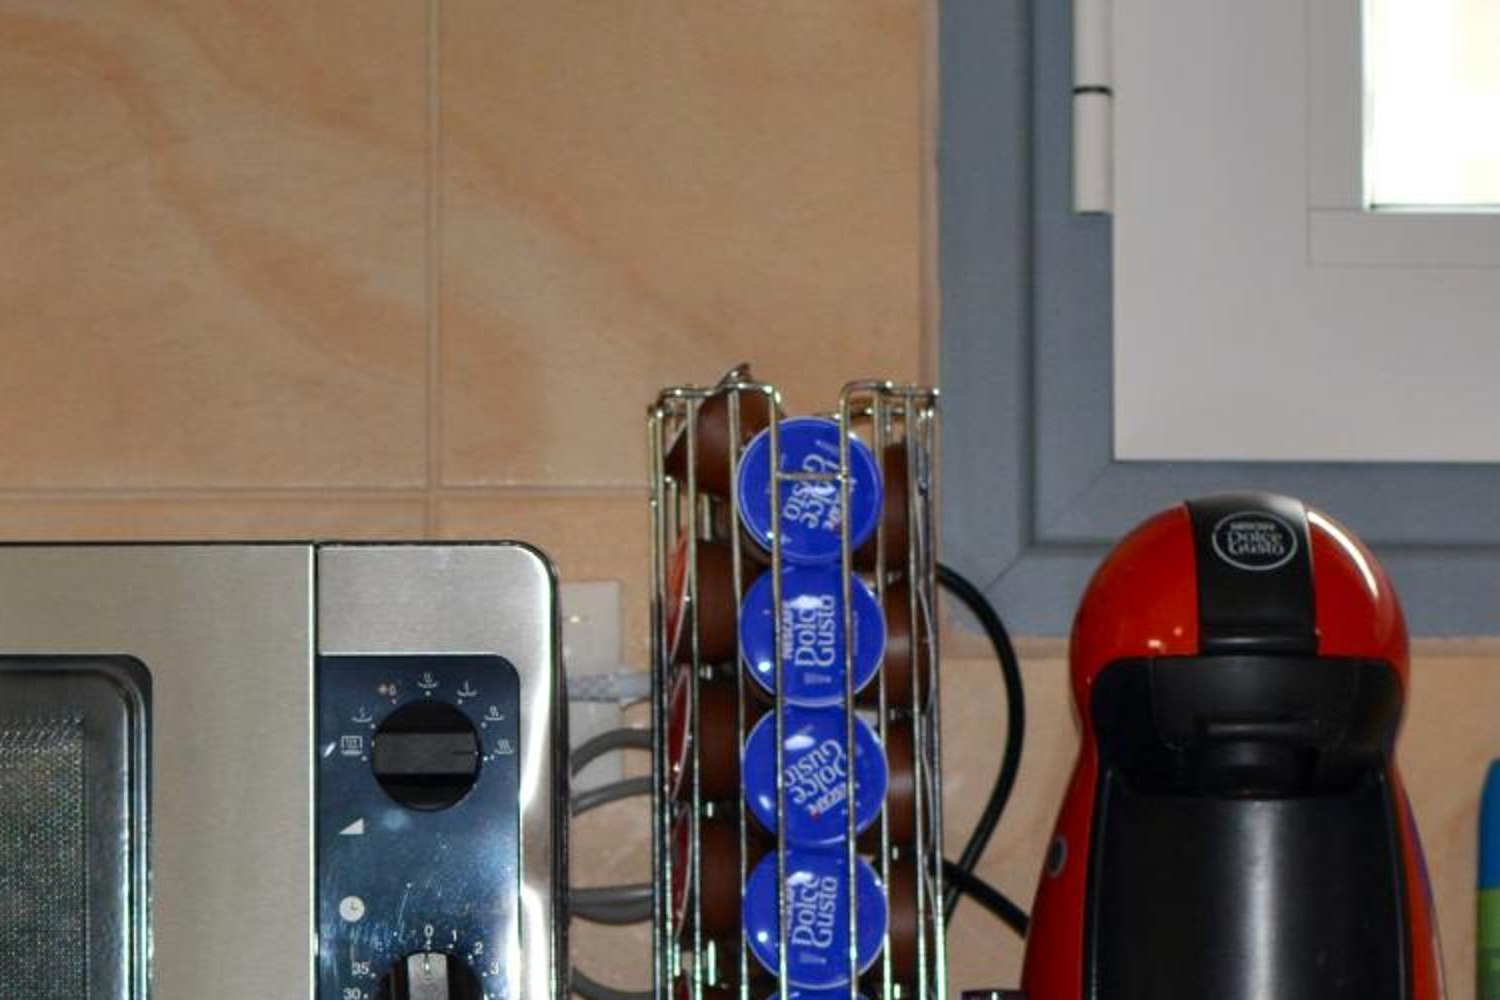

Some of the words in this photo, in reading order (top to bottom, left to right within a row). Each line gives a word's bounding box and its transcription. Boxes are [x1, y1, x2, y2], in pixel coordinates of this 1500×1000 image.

[794, 597, 817, 667] Dolc
[811, 875, 838, 949] Gusto
[423, 924, 434, 938] 0
[474, 941, 484, 954] 2
[352, 962, 370, 976] 35
[343, 988, 361, 1000] 30
